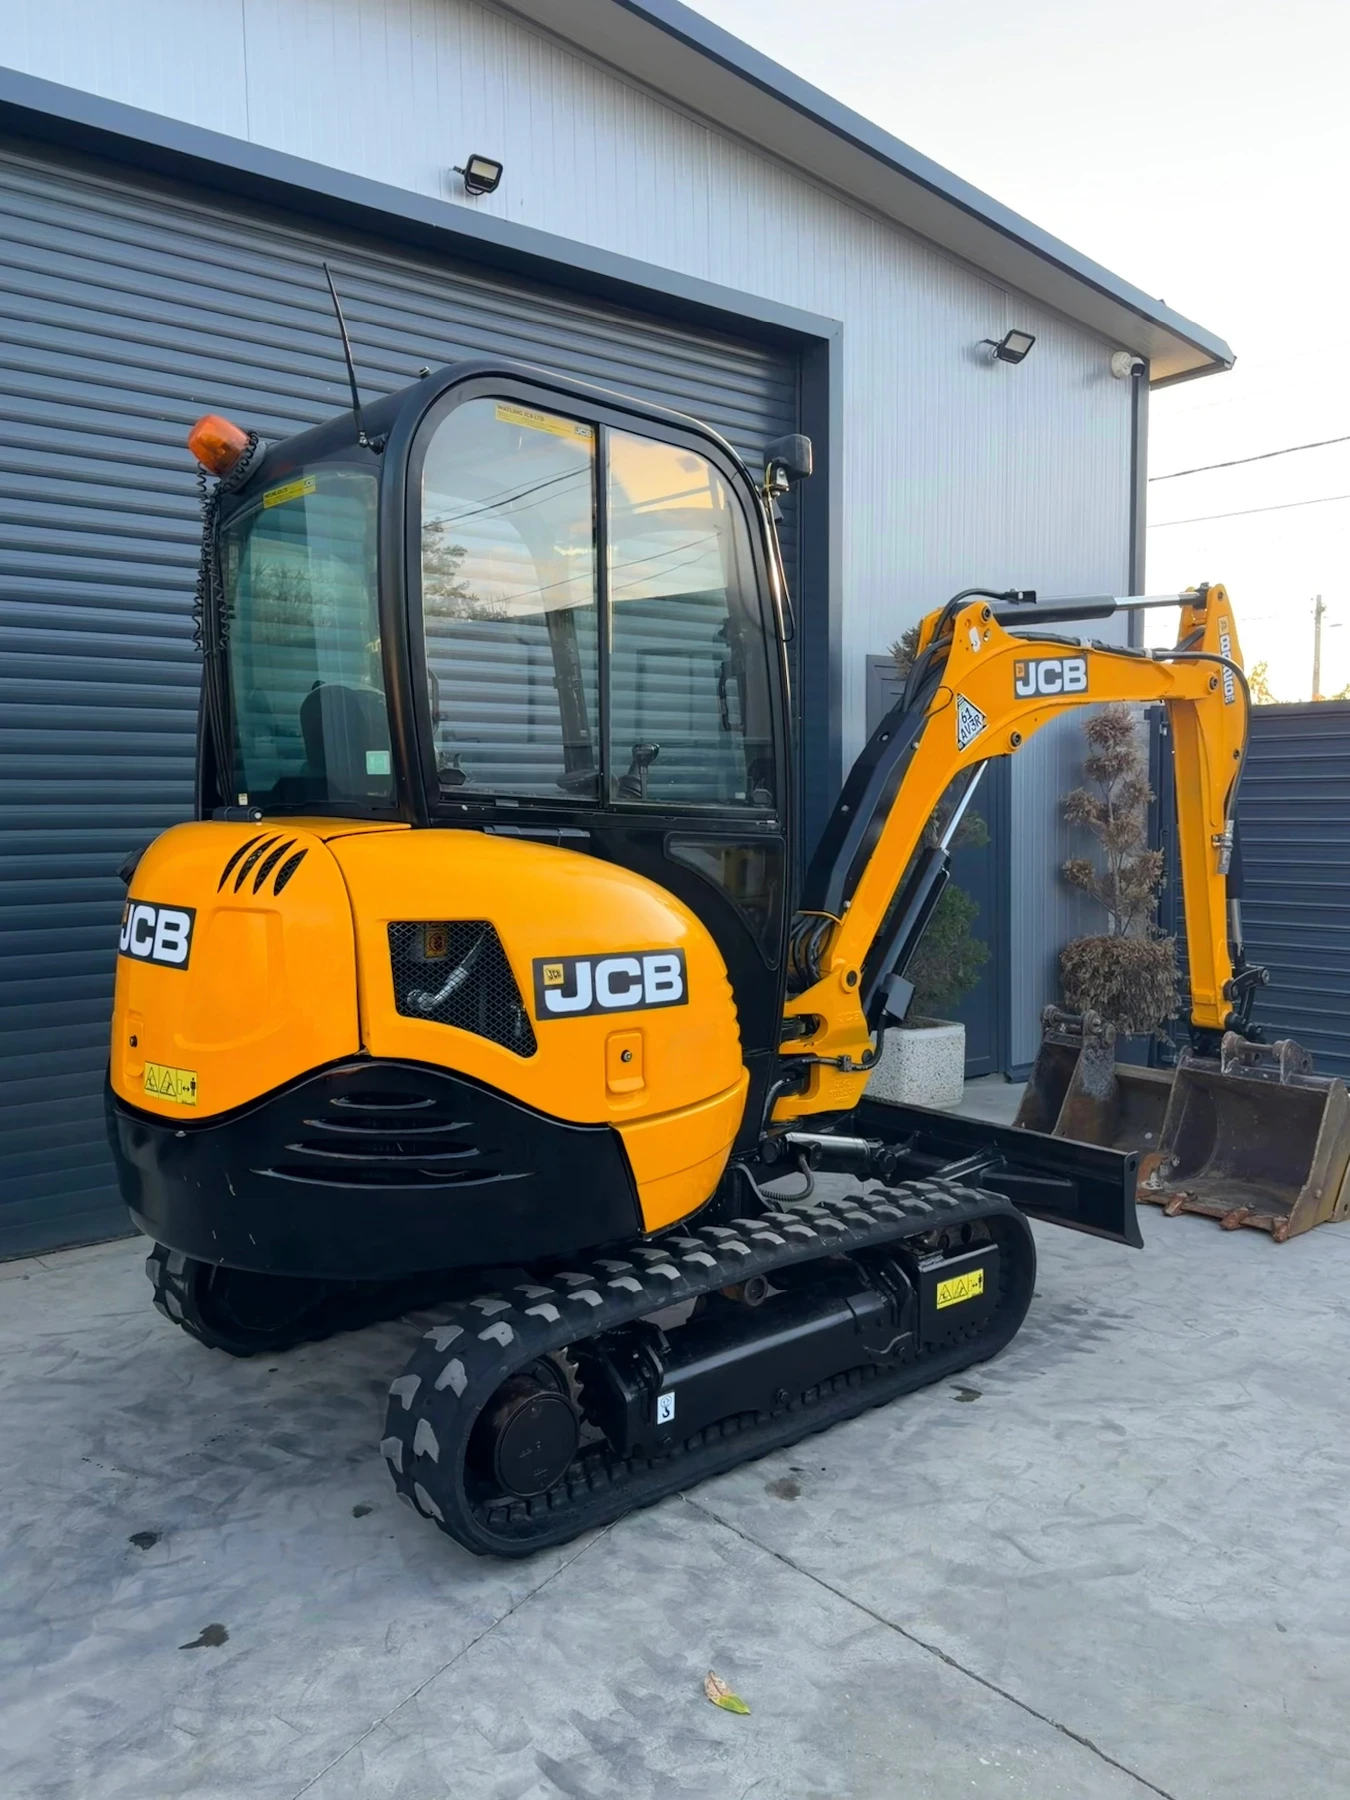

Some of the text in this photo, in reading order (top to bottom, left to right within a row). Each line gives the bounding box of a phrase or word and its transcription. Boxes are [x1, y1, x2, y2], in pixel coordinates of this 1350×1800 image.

[1015, 658, 1087, 696] JCB
[961, 707, 972, 724] 61
[961, 714, 982, 741] AV3R
[119, 903, 191, 964] JCB
[544, 954, 683, 1012] JCB
